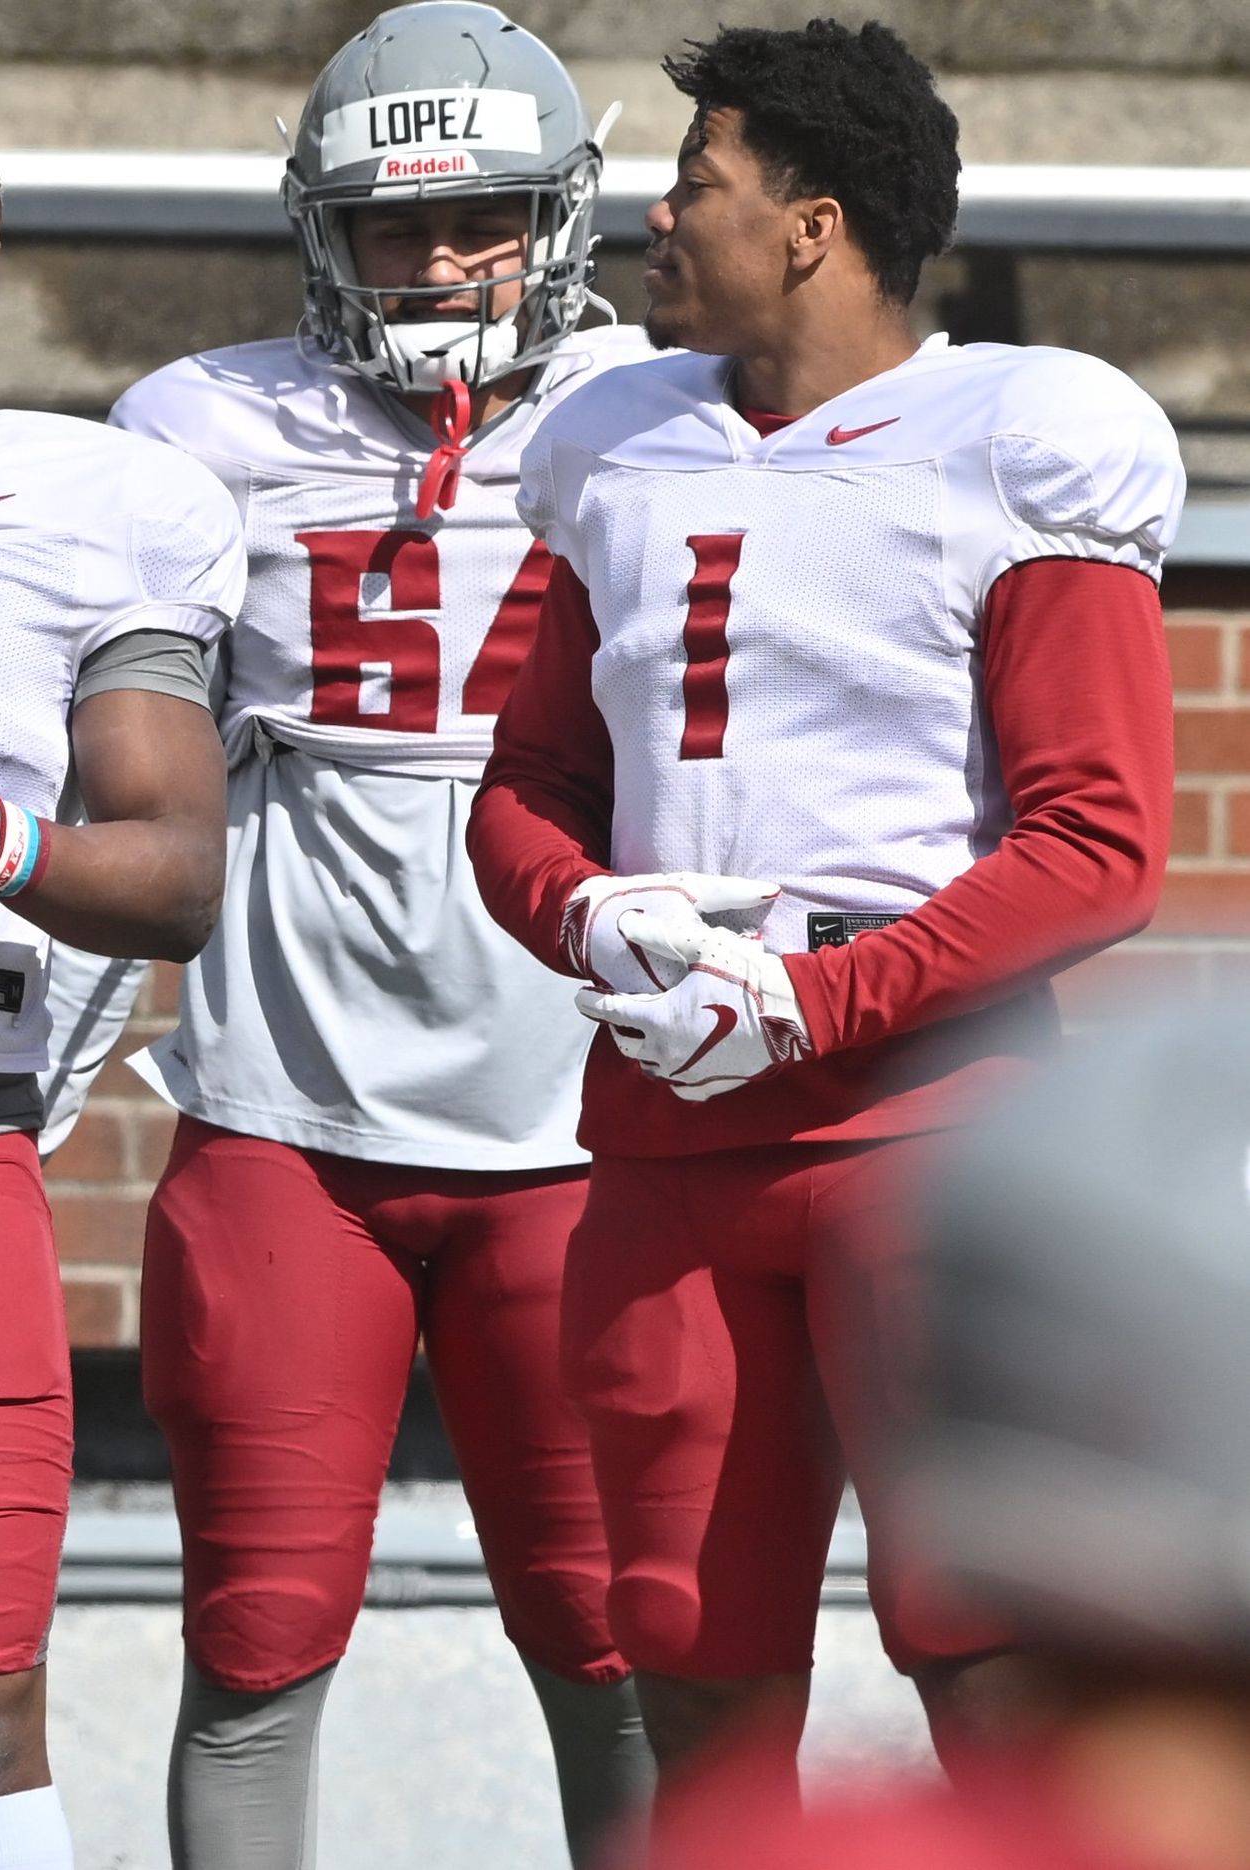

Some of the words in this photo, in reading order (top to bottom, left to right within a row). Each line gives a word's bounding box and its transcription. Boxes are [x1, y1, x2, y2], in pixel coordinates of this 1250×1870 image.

[368, 96, 483, 149] LOPEZ
[386, 156, 466, 178] Riddell
[678, 533, 747, 760] 1
